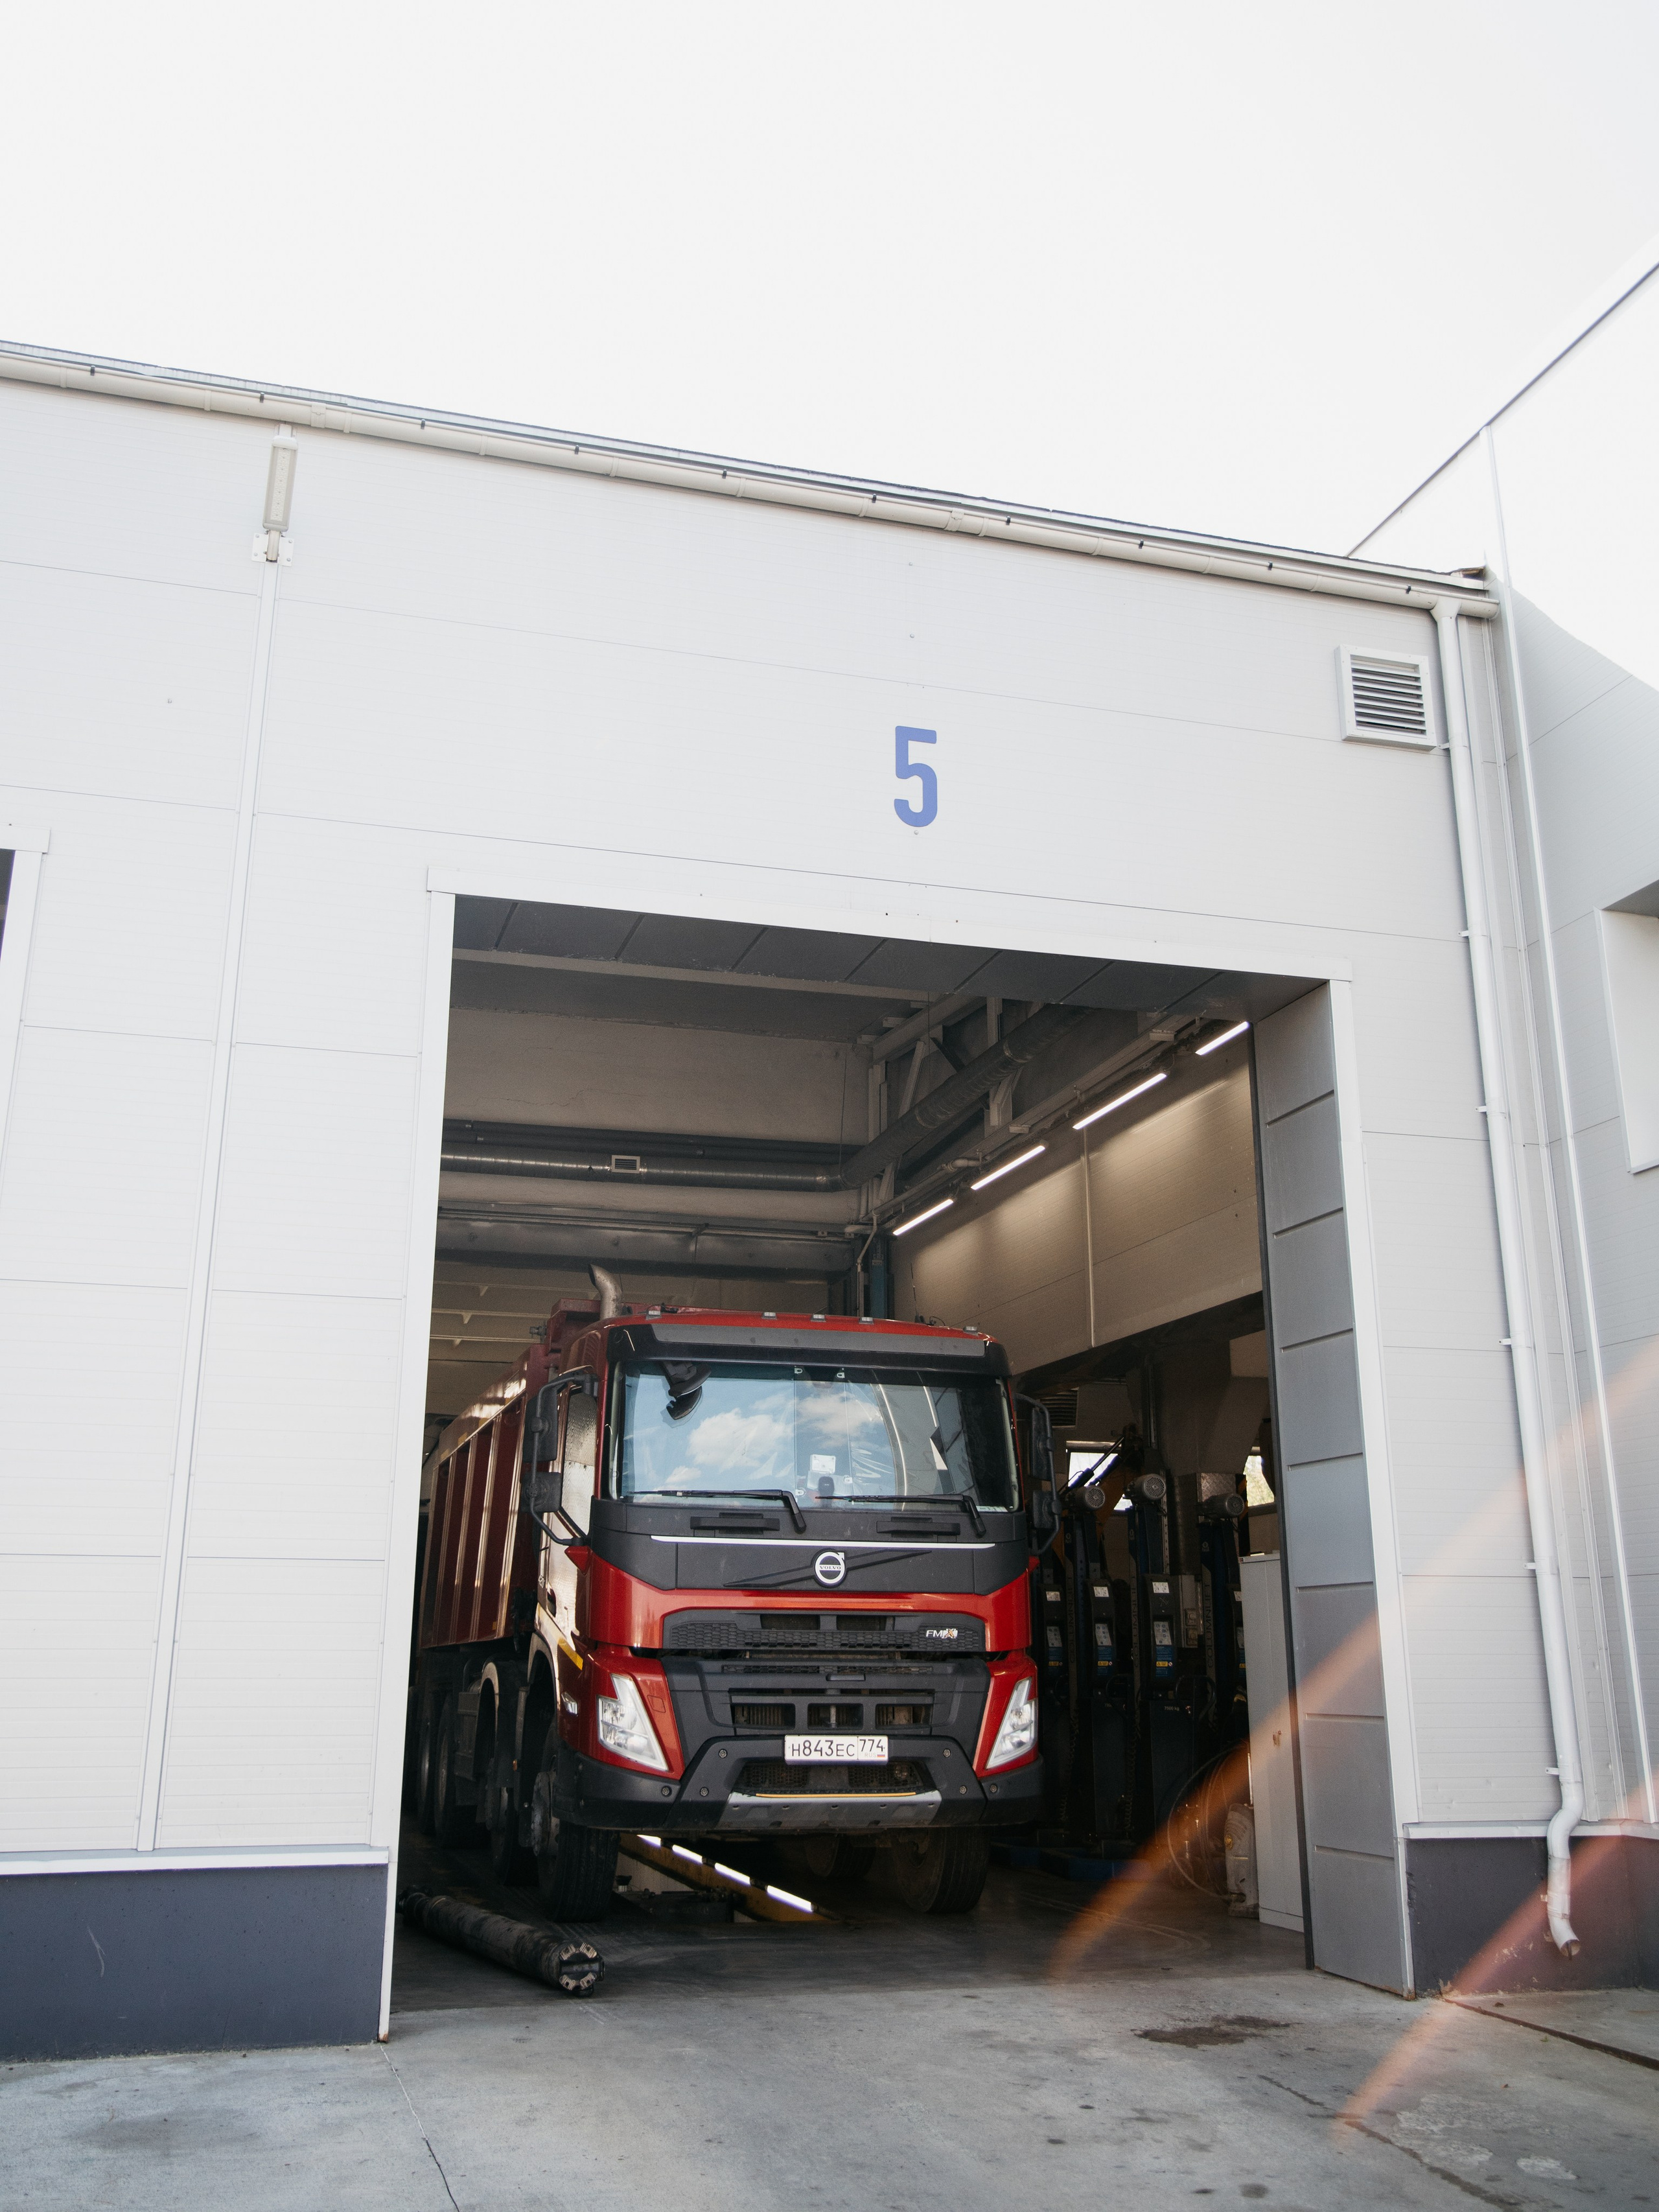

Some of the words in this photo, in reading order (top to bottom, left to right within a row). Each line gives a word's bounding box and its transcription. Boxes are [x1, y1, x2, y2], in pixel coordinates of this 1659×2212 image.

[894, 725, 938, 828] 5
[925, 1628, 958, 1639] FMX
[859, 1739, 883, 1752] 774
